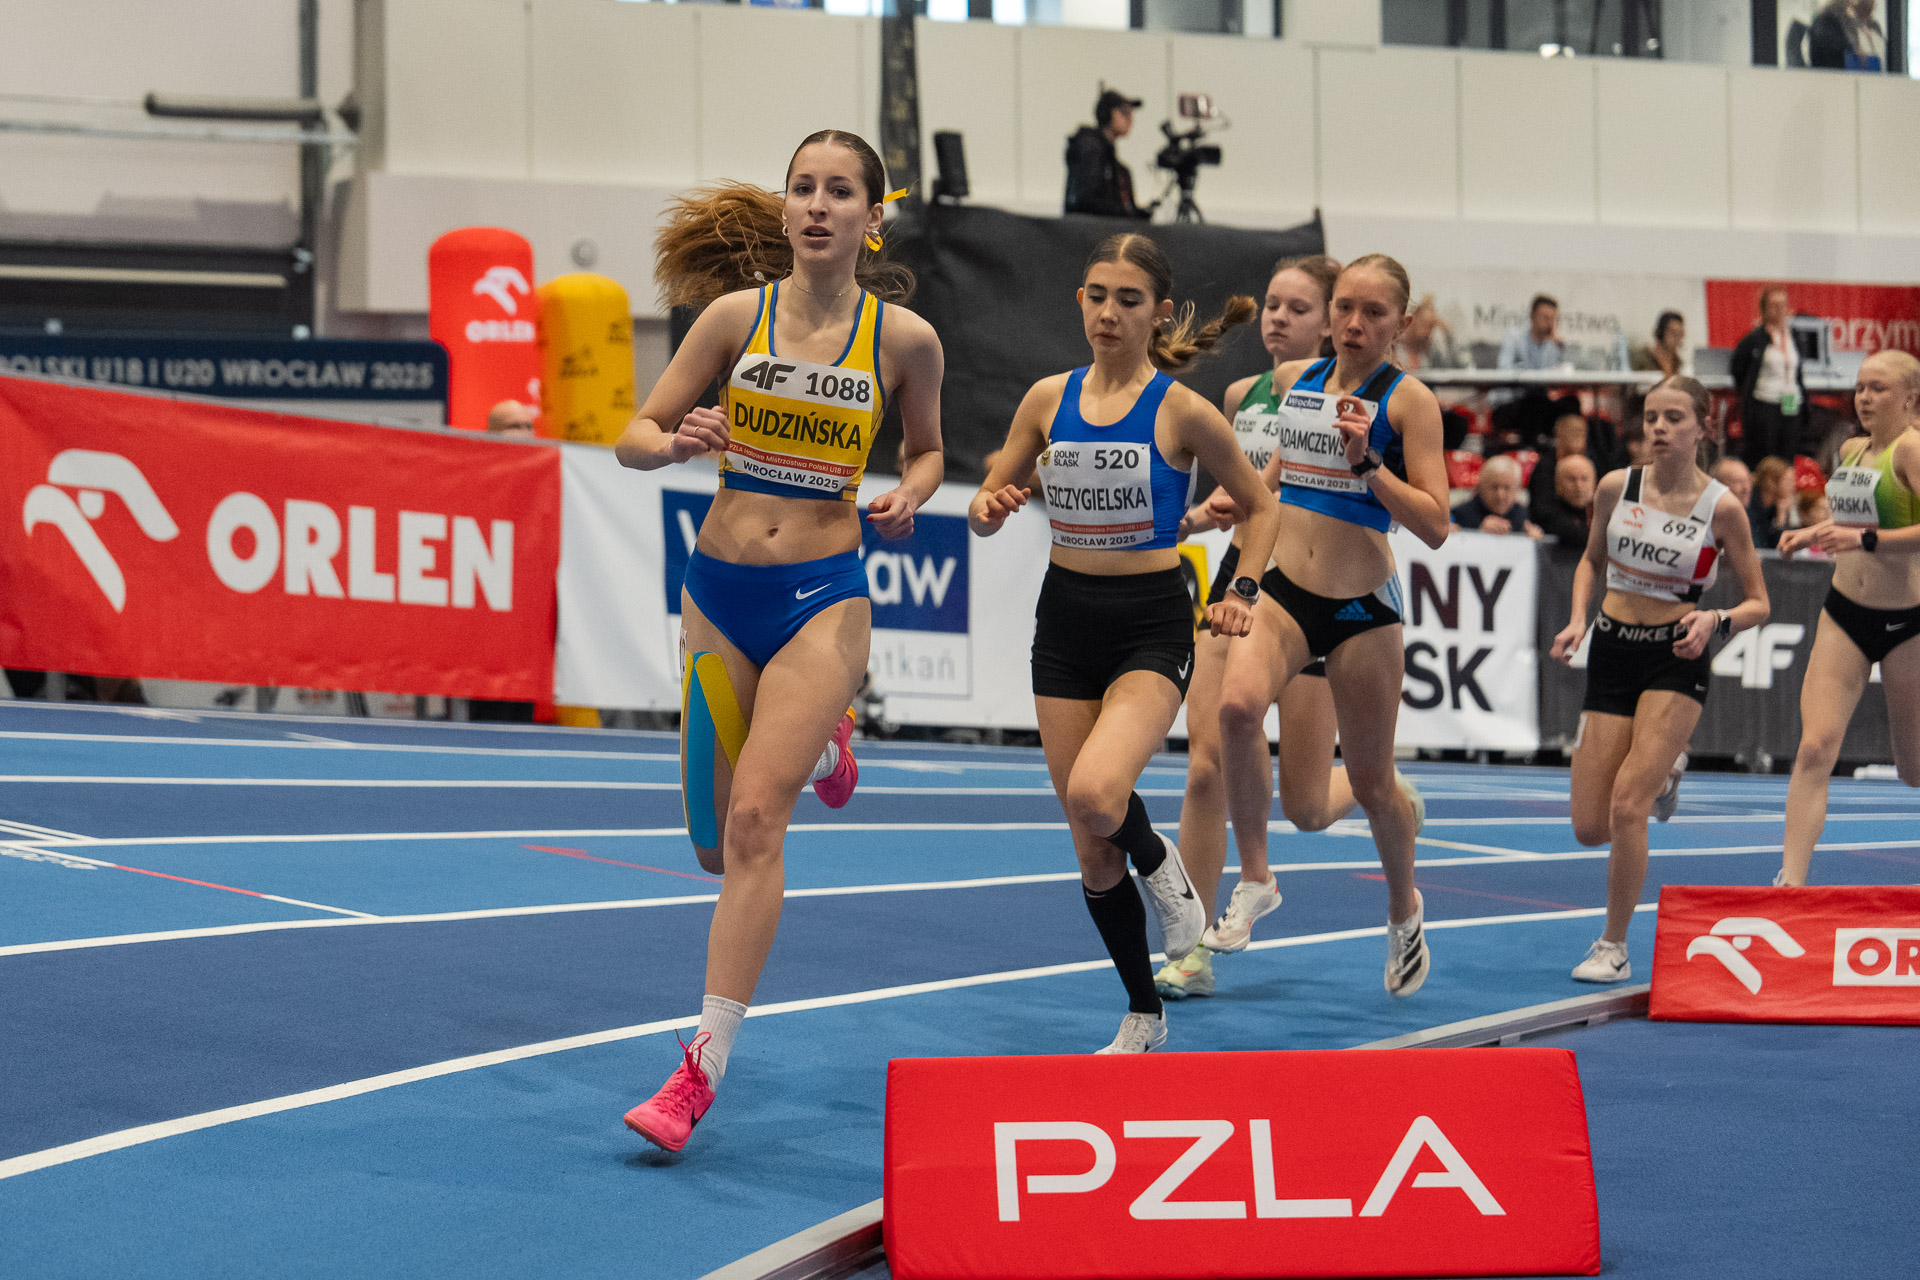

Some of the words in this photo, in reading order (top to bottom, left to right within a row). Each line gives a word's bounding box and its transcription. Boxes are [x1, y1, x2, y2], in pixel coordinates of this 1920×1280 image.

[163, 358, 217, 388] U20
[220, 359, 367, 388] WROCŁAW
[370, 361, 435, 390] 2025
[740, 360, 796, 391] 4F
[805, 372, 870, 403] 1088
[1287, 395, 1323, 409] Wrocław
[735, 401, 861, 451] DUDZIŃSKA
[1054, 450, 1080, 459] DOLNY
[1280, 427, 1345, 456] ADAMCZEWS
[729, 443, 743, 453] PZLA
[744, 448, 765, 460] Halowe
[766, 455, 807, 468] Mistrzostwa
[808, 462, 829, 471] Polski
[830, 466, 842, 474] U18
[1054, 457, 1079, 468] ŚLĄSK
[1094, 449, 1140, 470] 520
[743, 460, 806, 483] WROCŁAW
[808, 475, 839, 489] 2025
[1327, 480, 1351, 490] 2025
[1047, 484, 1148, 511] SZCZYGIELSKA
[1829, 493, 1873, 515] ÓRSKA
[1061, 535, 1106, 546] WROCŁAW
[1109, 535, 1137, 545] 2025
[1662, 520, 1697, 540] 692
[207, 491, 515, 612] ORLEN
[1617, 536, 1682, 569] PYRCZ
[1405, 561, 1512, 632] NY
[1335, 612, 1373, 621] adidas
[1617, 626, 1669, 642] NIKE
[1711, 623, 1805, 689] 4F
[1402, 641, 1494, 712] SK
[1847, 936, 1920, 977] OR
[994, 1115, 1507, 1222] PZLA
